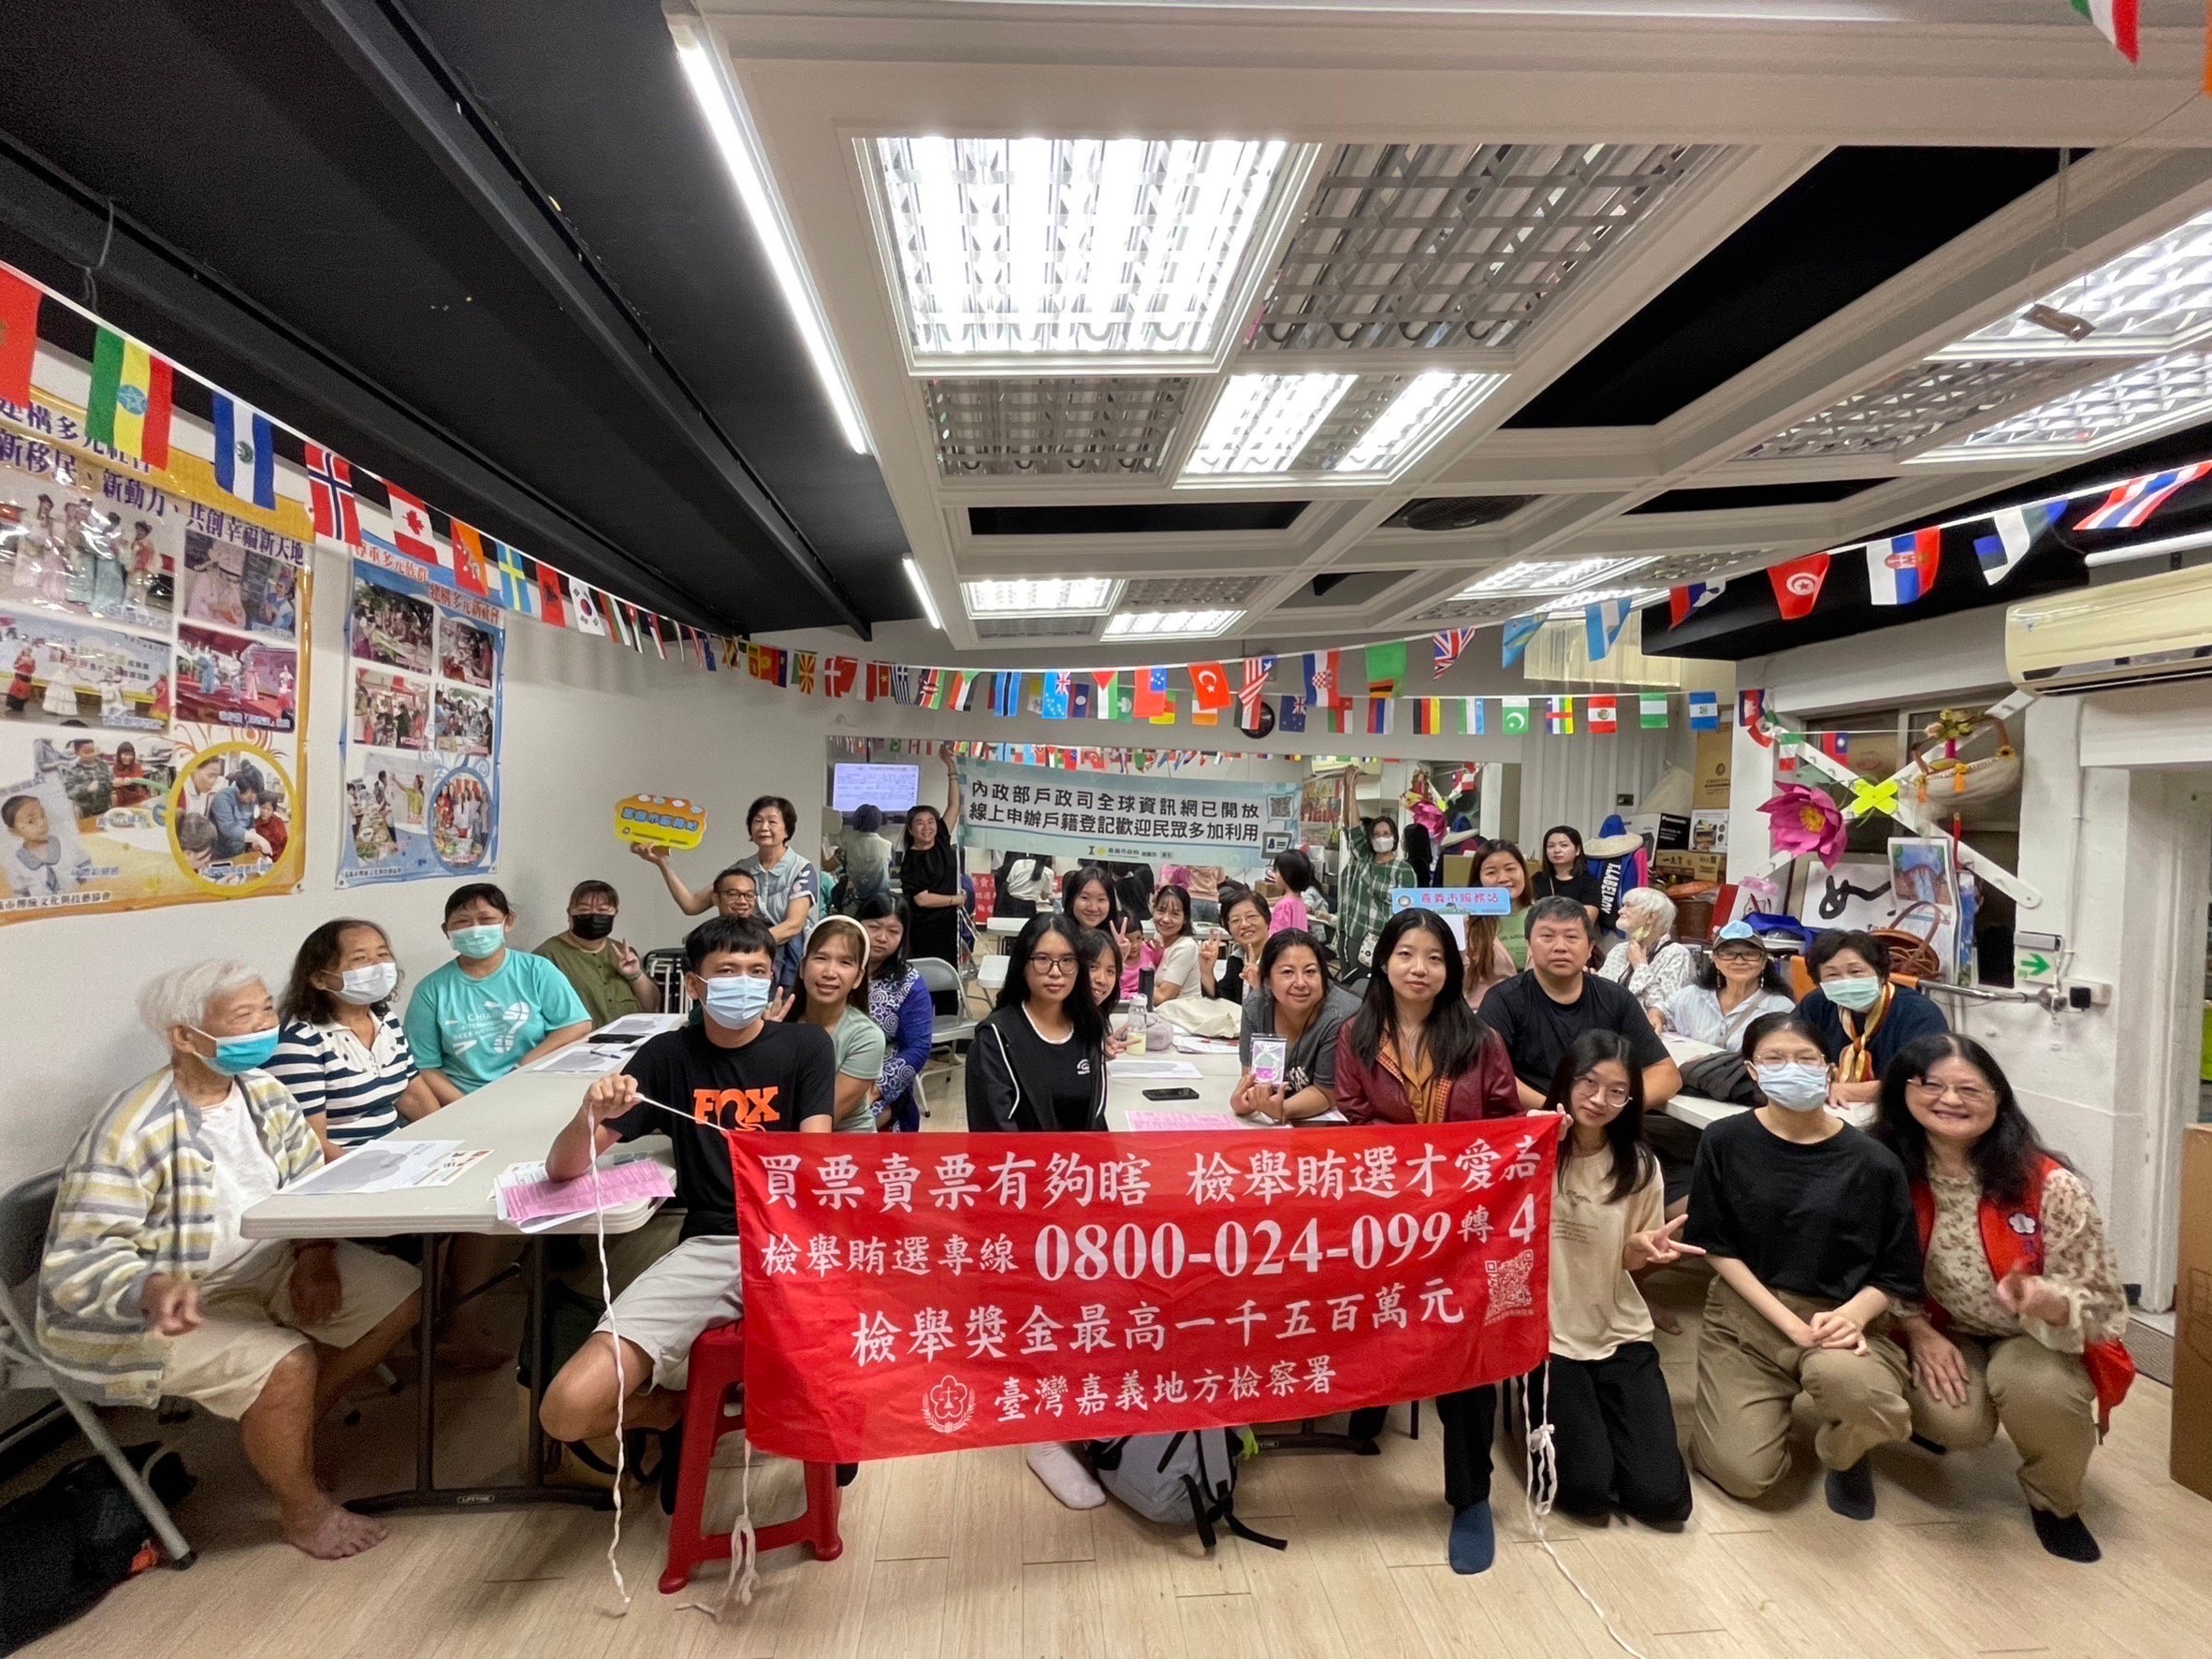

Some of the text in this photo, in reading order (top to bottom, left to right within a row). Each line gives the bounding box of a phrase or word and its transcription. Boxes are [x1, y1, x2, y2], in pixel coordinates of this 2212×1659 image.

[968, 802, 1259, 841] 線上申辦戶籍登記歡迎民眾多加利用
[972, 779, 1259, 819] 內政部戶政司全球資訊網已開放
[693, 1086, 780, 1131] FOX
[759, 1134, 1542, 1214] 買票賣票有夠瞎 檢舉賄選才愛嘉
[760, 1231, 1019, 1278] 檢舉賄選專線
[1034, 1211, 1451, 1282] 0800-024-099
[1456, 1203, 1494, 1244] 轉
[1508, 1193, 1537, 1245] 4
[851, 1278, 1465, 1367] 檢舉獎金最高一千五百萬元
[994, 1355, 1336, 1424] 臺灣嘉義地方檢察署
